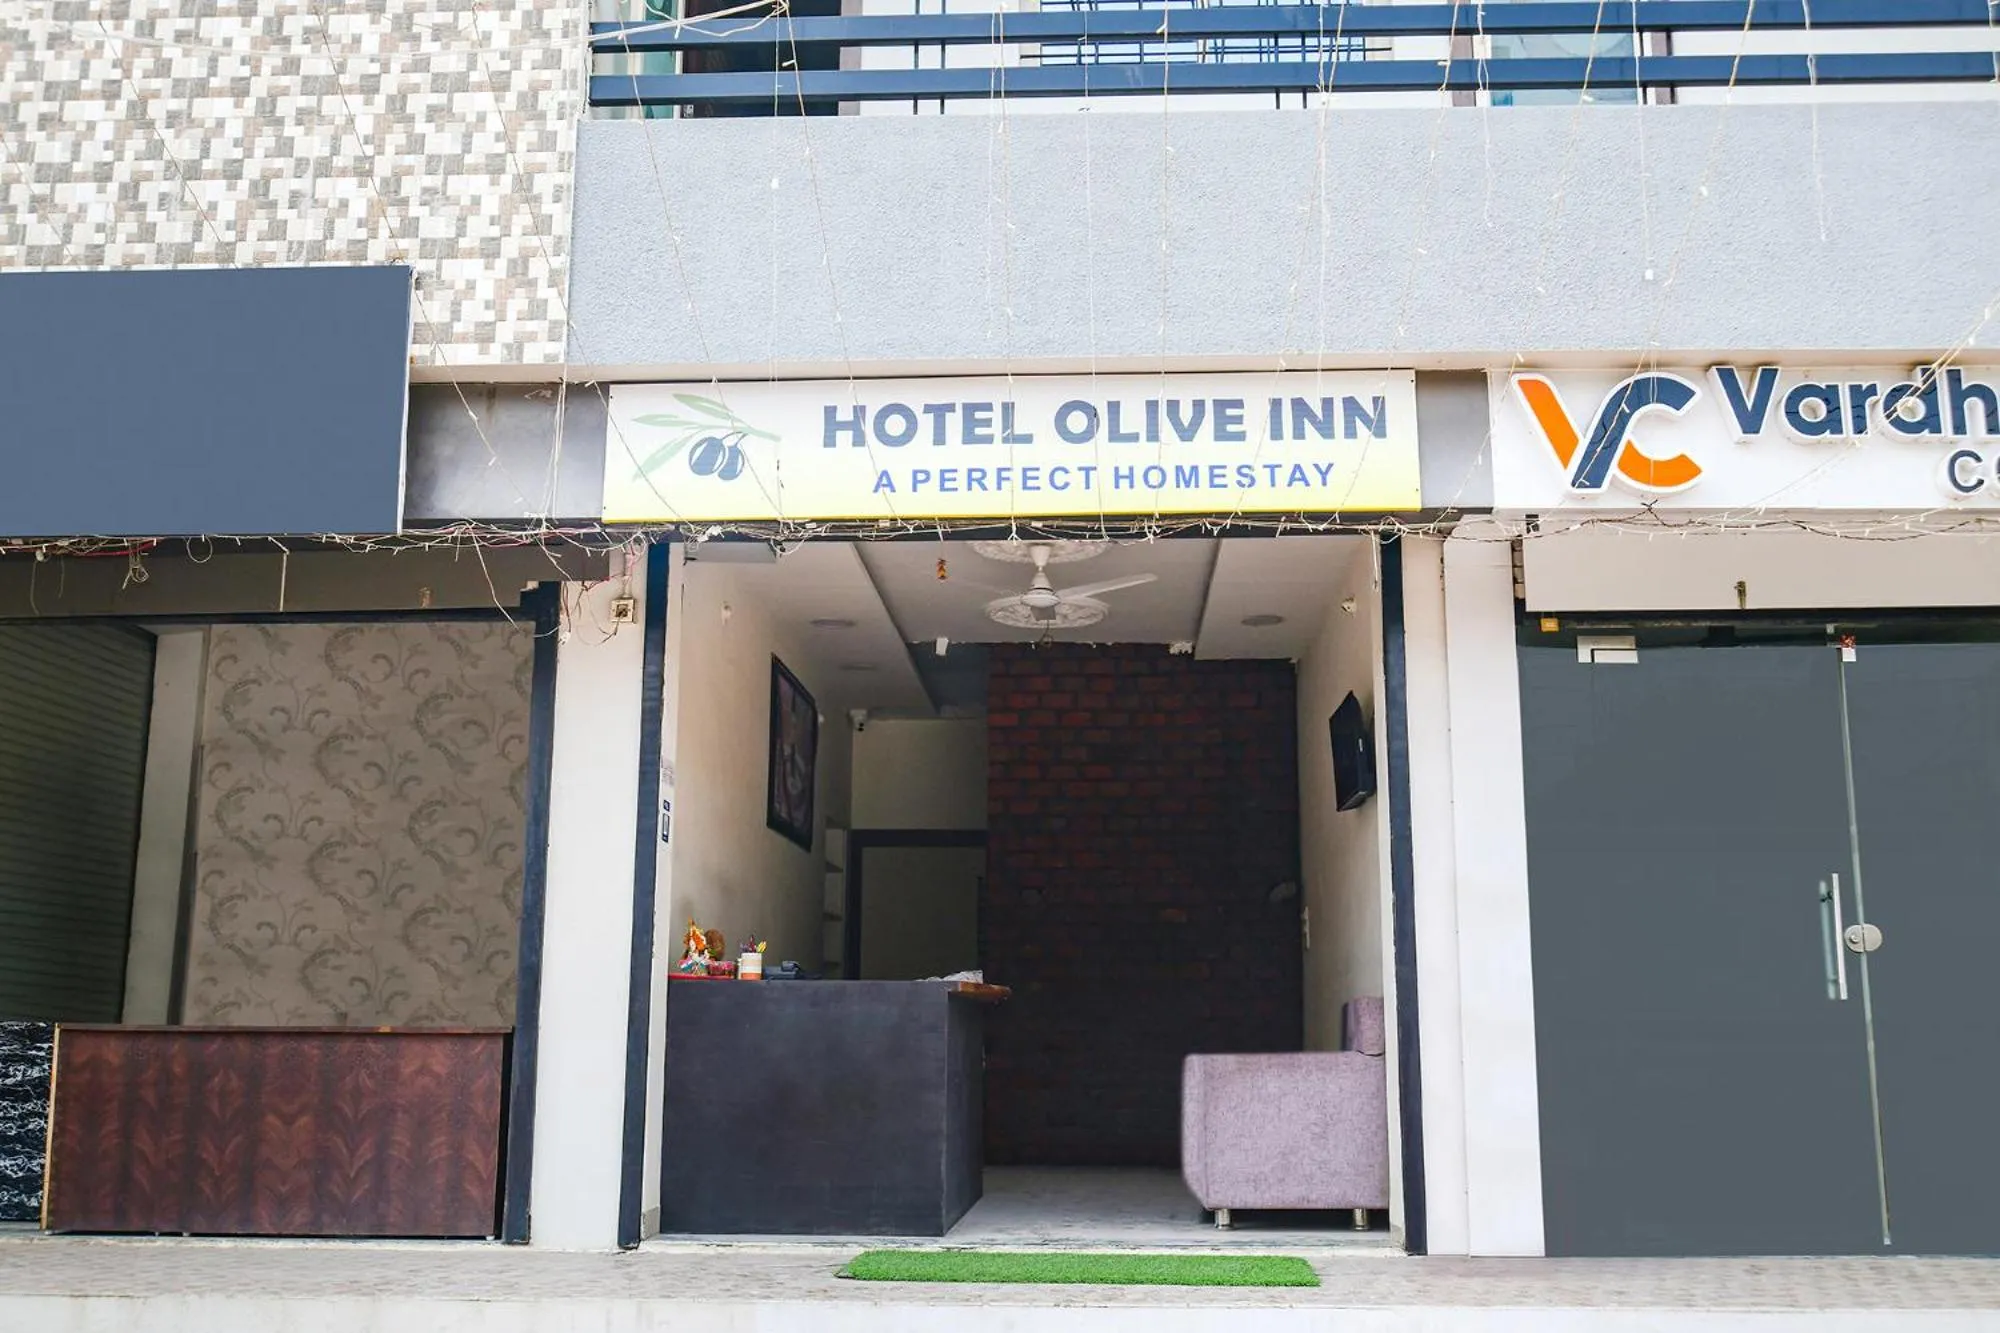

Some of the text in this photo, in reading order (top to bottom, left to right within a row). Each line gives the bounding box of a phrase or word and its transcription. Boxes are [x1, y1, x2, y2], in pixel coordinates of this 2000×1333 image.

[823, 396, 1388, 448] HOTEL OLIVE INN
[873, 463, 1335, 493] A PERFECT HOMESTAY
